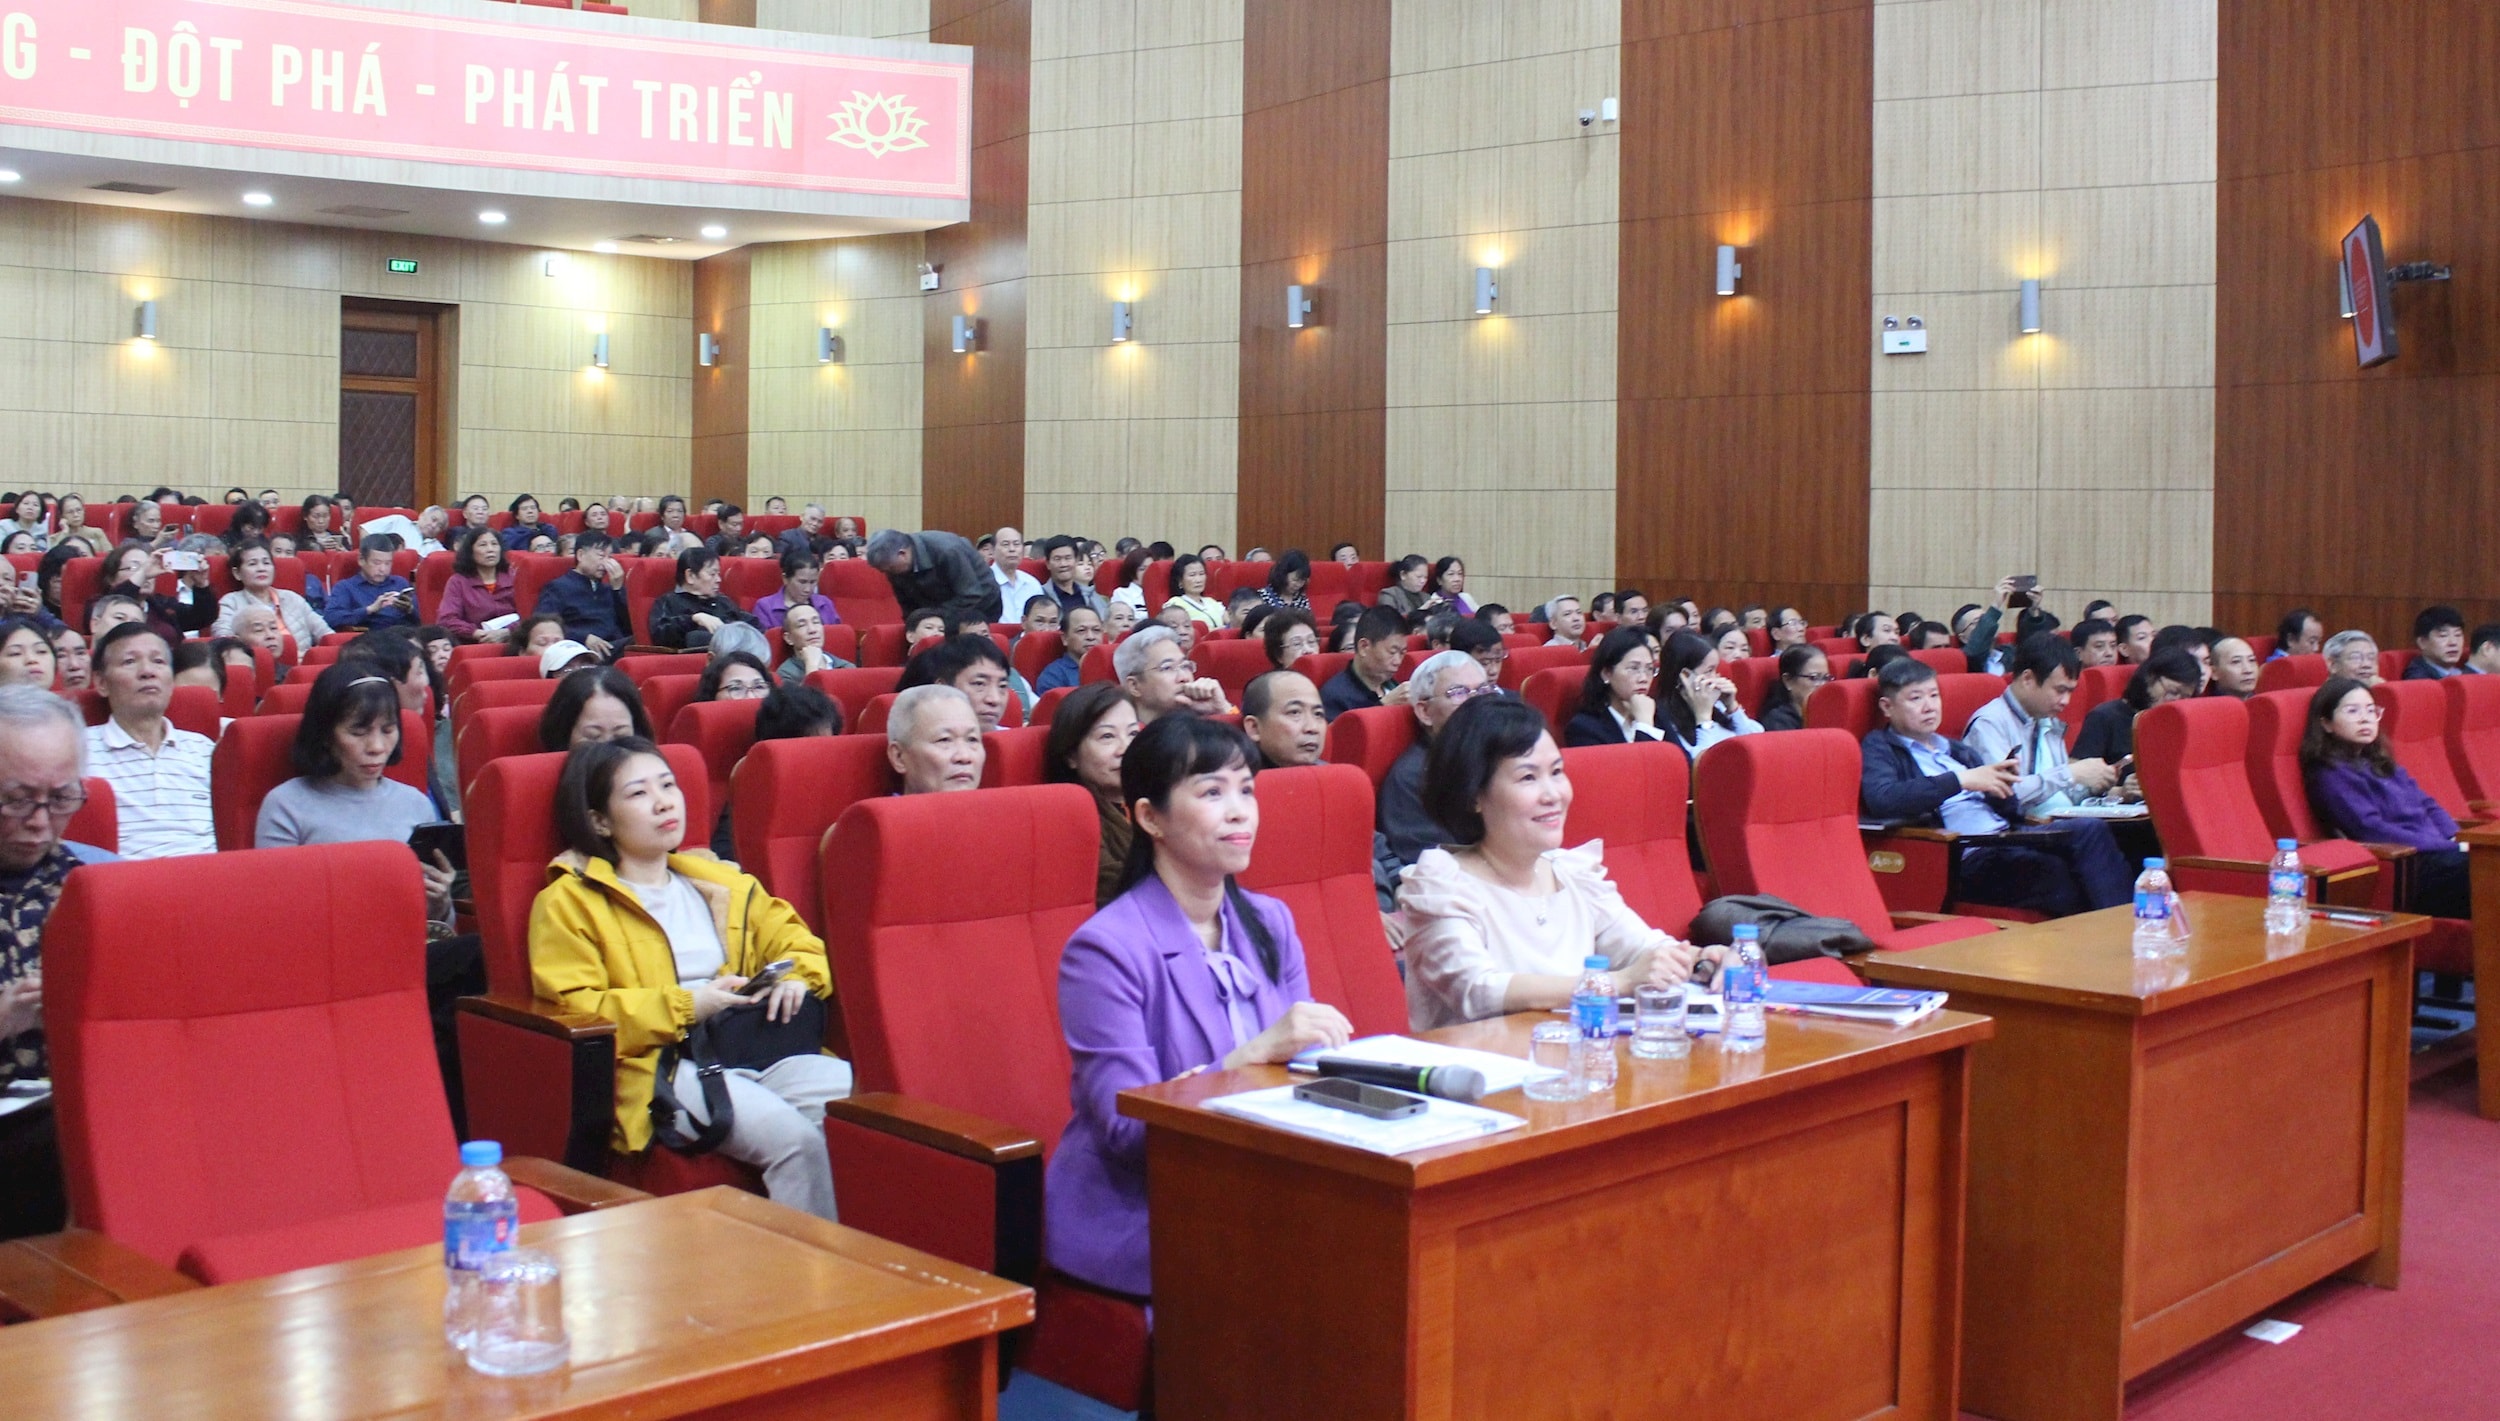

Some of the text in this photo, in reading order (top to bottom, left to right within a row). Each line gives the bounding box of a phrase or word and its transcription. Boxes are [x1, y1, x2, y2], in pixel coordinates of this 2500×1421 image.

[70, 47, 91, 60] -
[121, 20, 243, 108] ĐỘT
[271, 42, 388, 117] PHÁ
[416, 83, 435, 96] -
[465, 61, 608, 135] PHÁT
[632, 70, 793, 149] TRIỂN
[391, 260, 417, 272] EXIT
